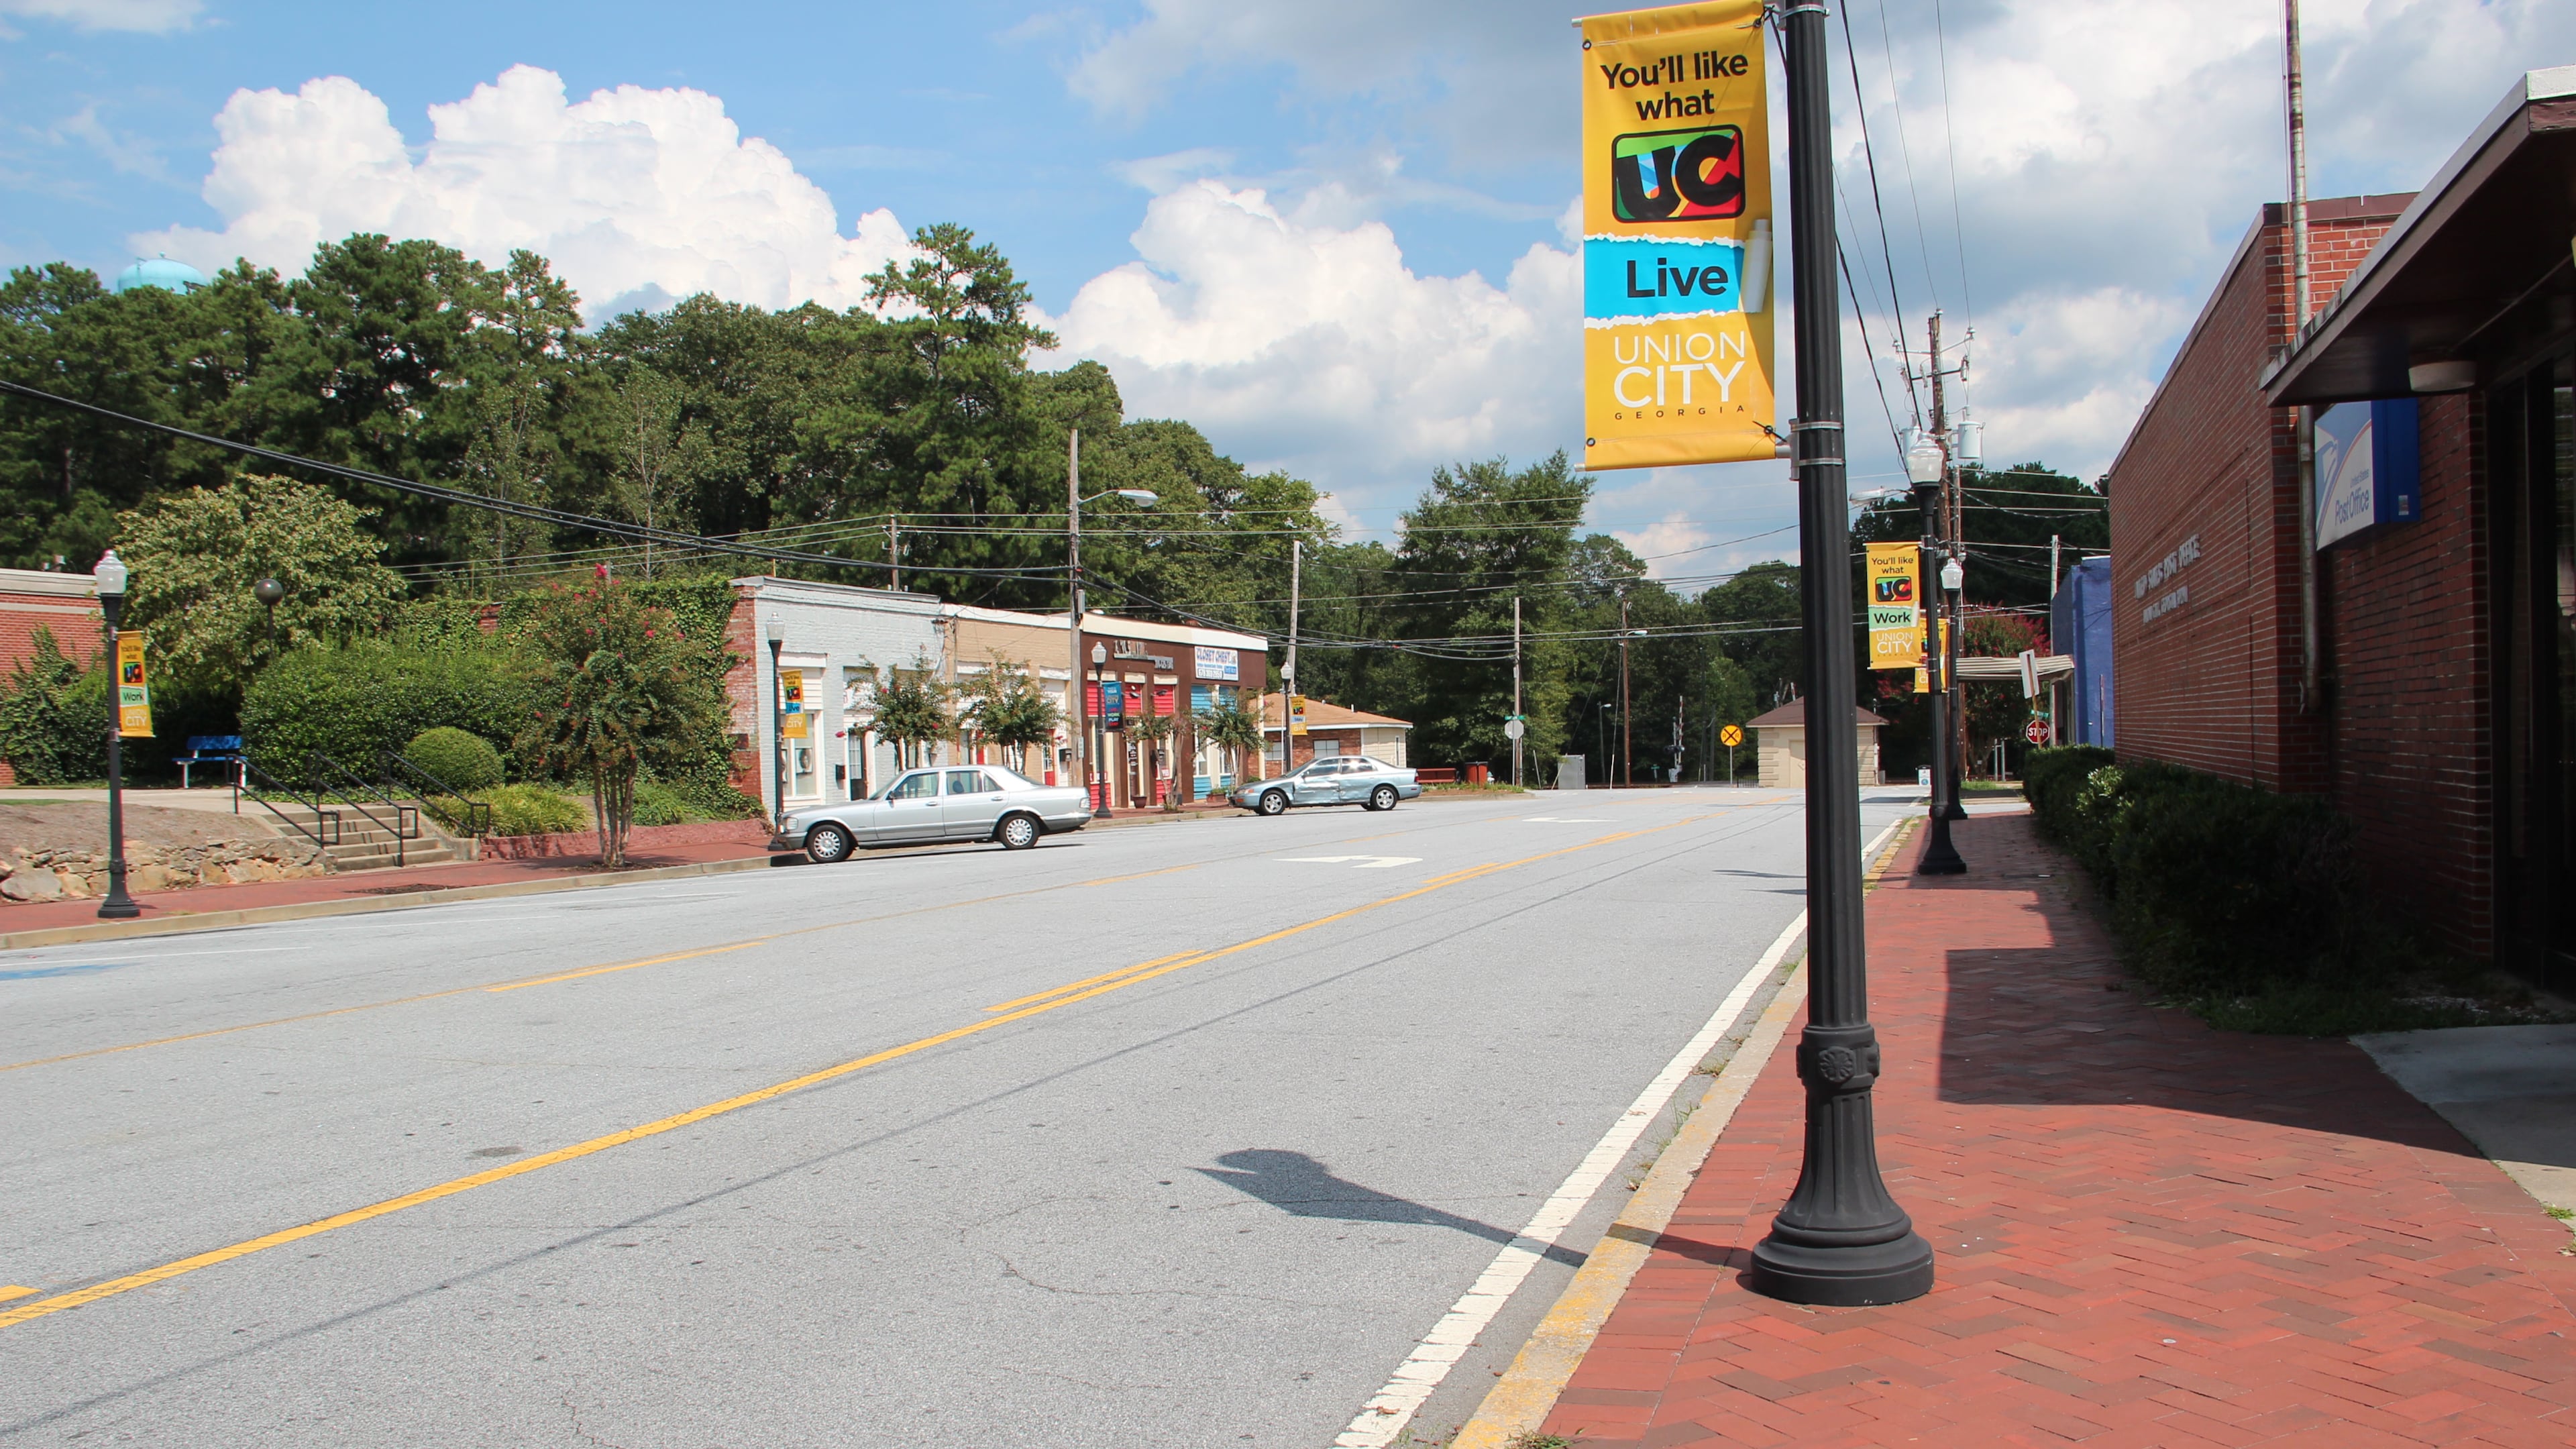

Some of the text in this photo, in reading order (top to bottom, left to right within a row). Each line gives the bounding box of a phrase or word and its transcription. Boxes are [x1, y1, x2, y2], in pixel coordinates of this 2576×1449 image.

[1600, 50, 1748, 89] You'll like
[1635, 89, 1715, 121] what
[1616, 134, 1741, 219] UC
[1626, 258, 1728, 298] Live
[1615, 331, 1745, 364] UNION
[1614, 361, 1746, 408] CITY
[1615, 405, 1745, 420] GEORGIA
[2334, 487, 2369, 526] Post Office
[1872, 557, 1895, 565] You'll
[1877, 579, 1911, 600] UC
[1874, 611, 1911, 624] Work
[1876, 632, 1913, 641] UNION
[1877, 641, 1913, 654] CITY
[123, 692, 145, 702] Work
[125, 716, 147, 727] CITY
[786, 720, 803, 728] CITY
[2028, 727, 2047, 737] STOP
